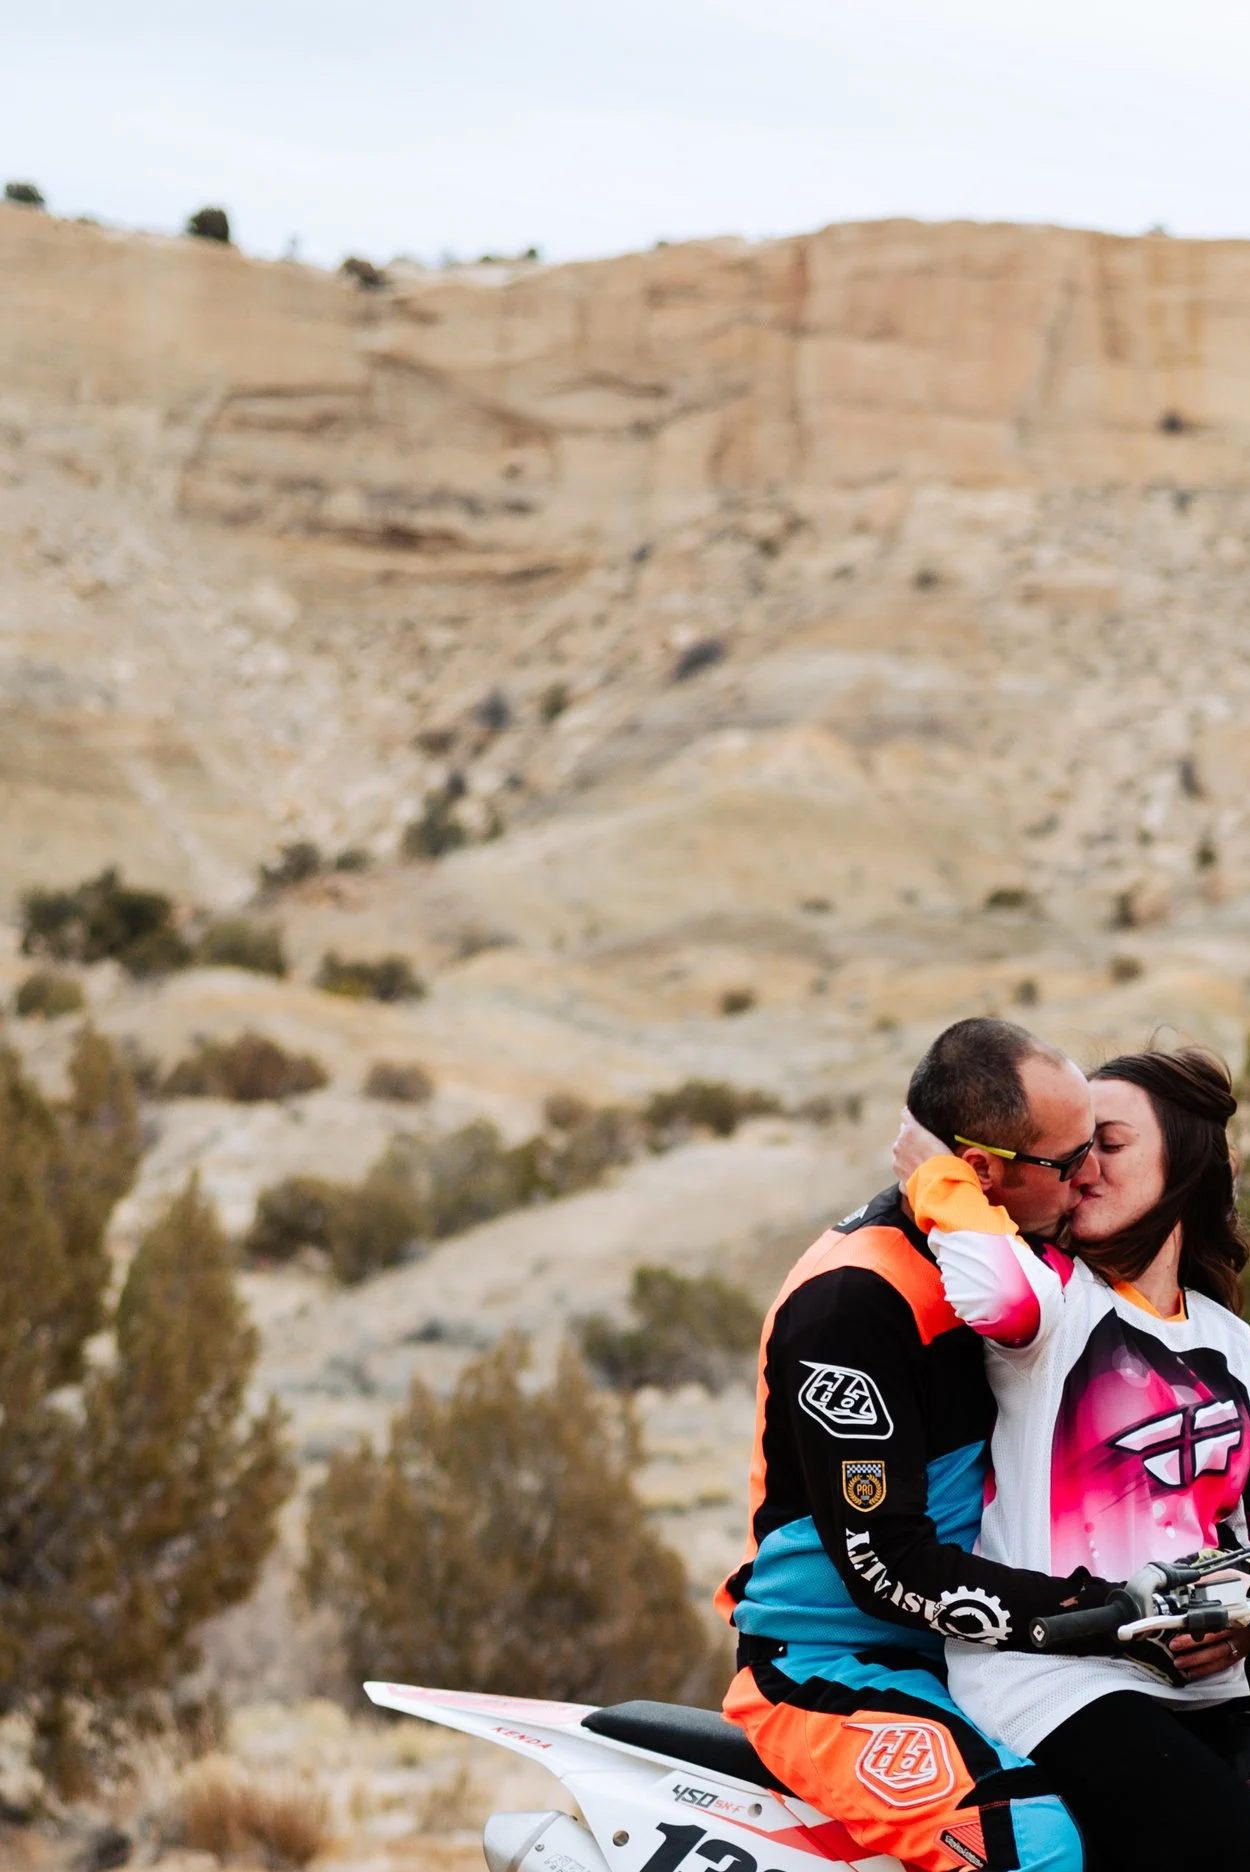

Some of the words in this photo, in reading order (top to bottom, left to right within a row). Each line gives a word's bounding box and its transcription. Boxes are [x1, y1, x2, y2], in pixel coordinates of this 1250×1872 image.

[857, 1483, 873, 1496] PRO
[492, 1726, 553, 1750] KENDA
[672, 1784, 718, 1809] 450
